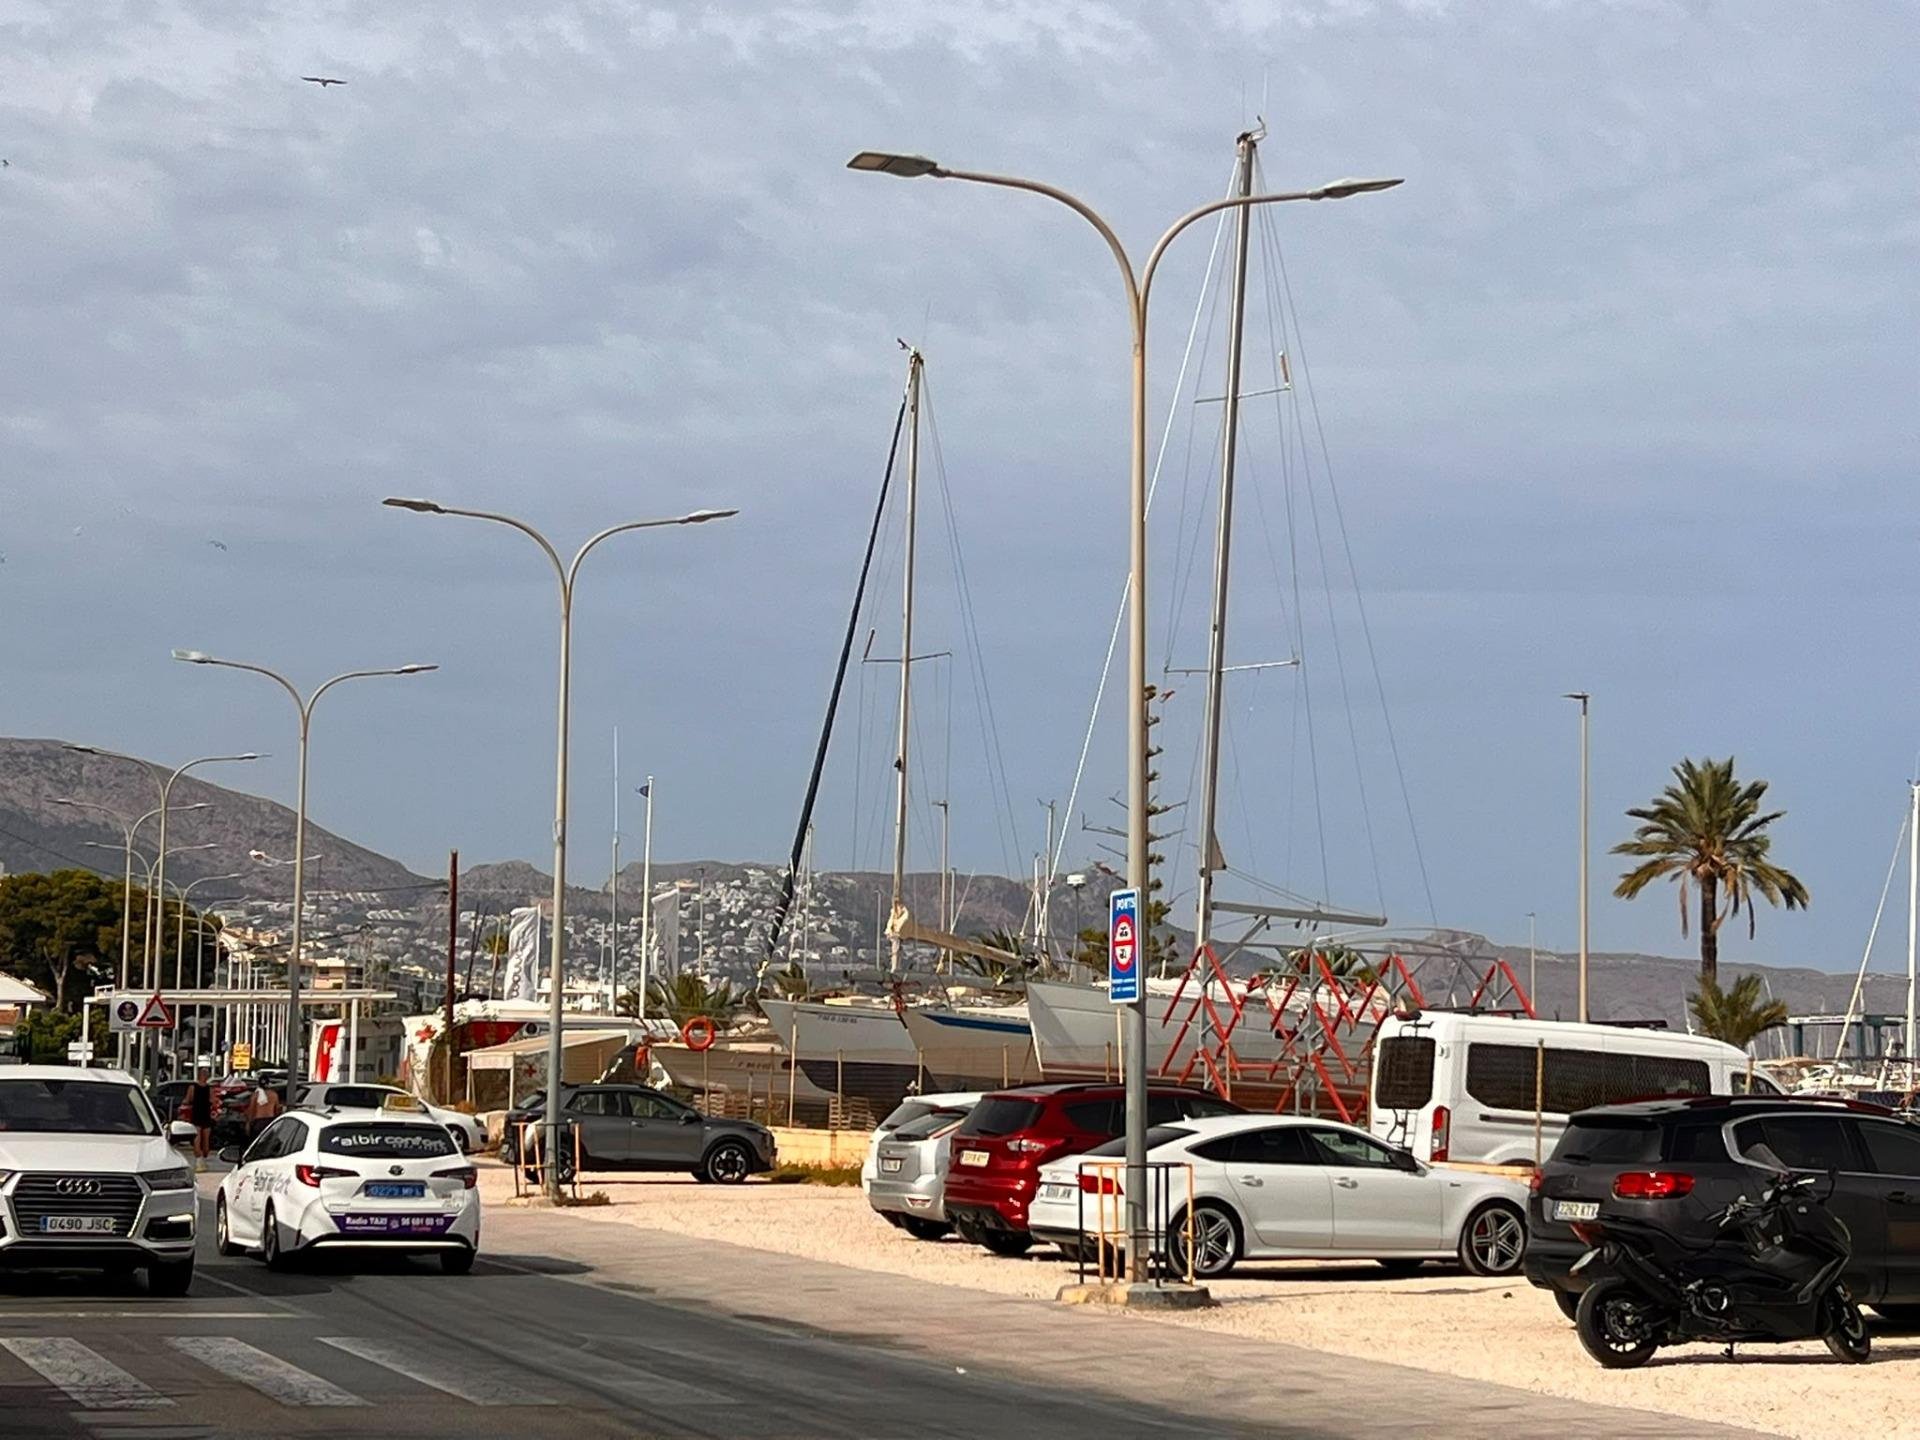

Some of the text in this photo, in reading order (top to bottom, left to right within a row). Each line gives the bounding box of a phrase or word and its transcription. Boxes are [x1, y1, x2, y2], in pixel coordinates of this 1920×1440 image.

[341, 1133, 382, 1147] albir
[49, 1218, 111, 1231] 0490 JSC
[345, 1216, 388, 1226] Radio TAXI
